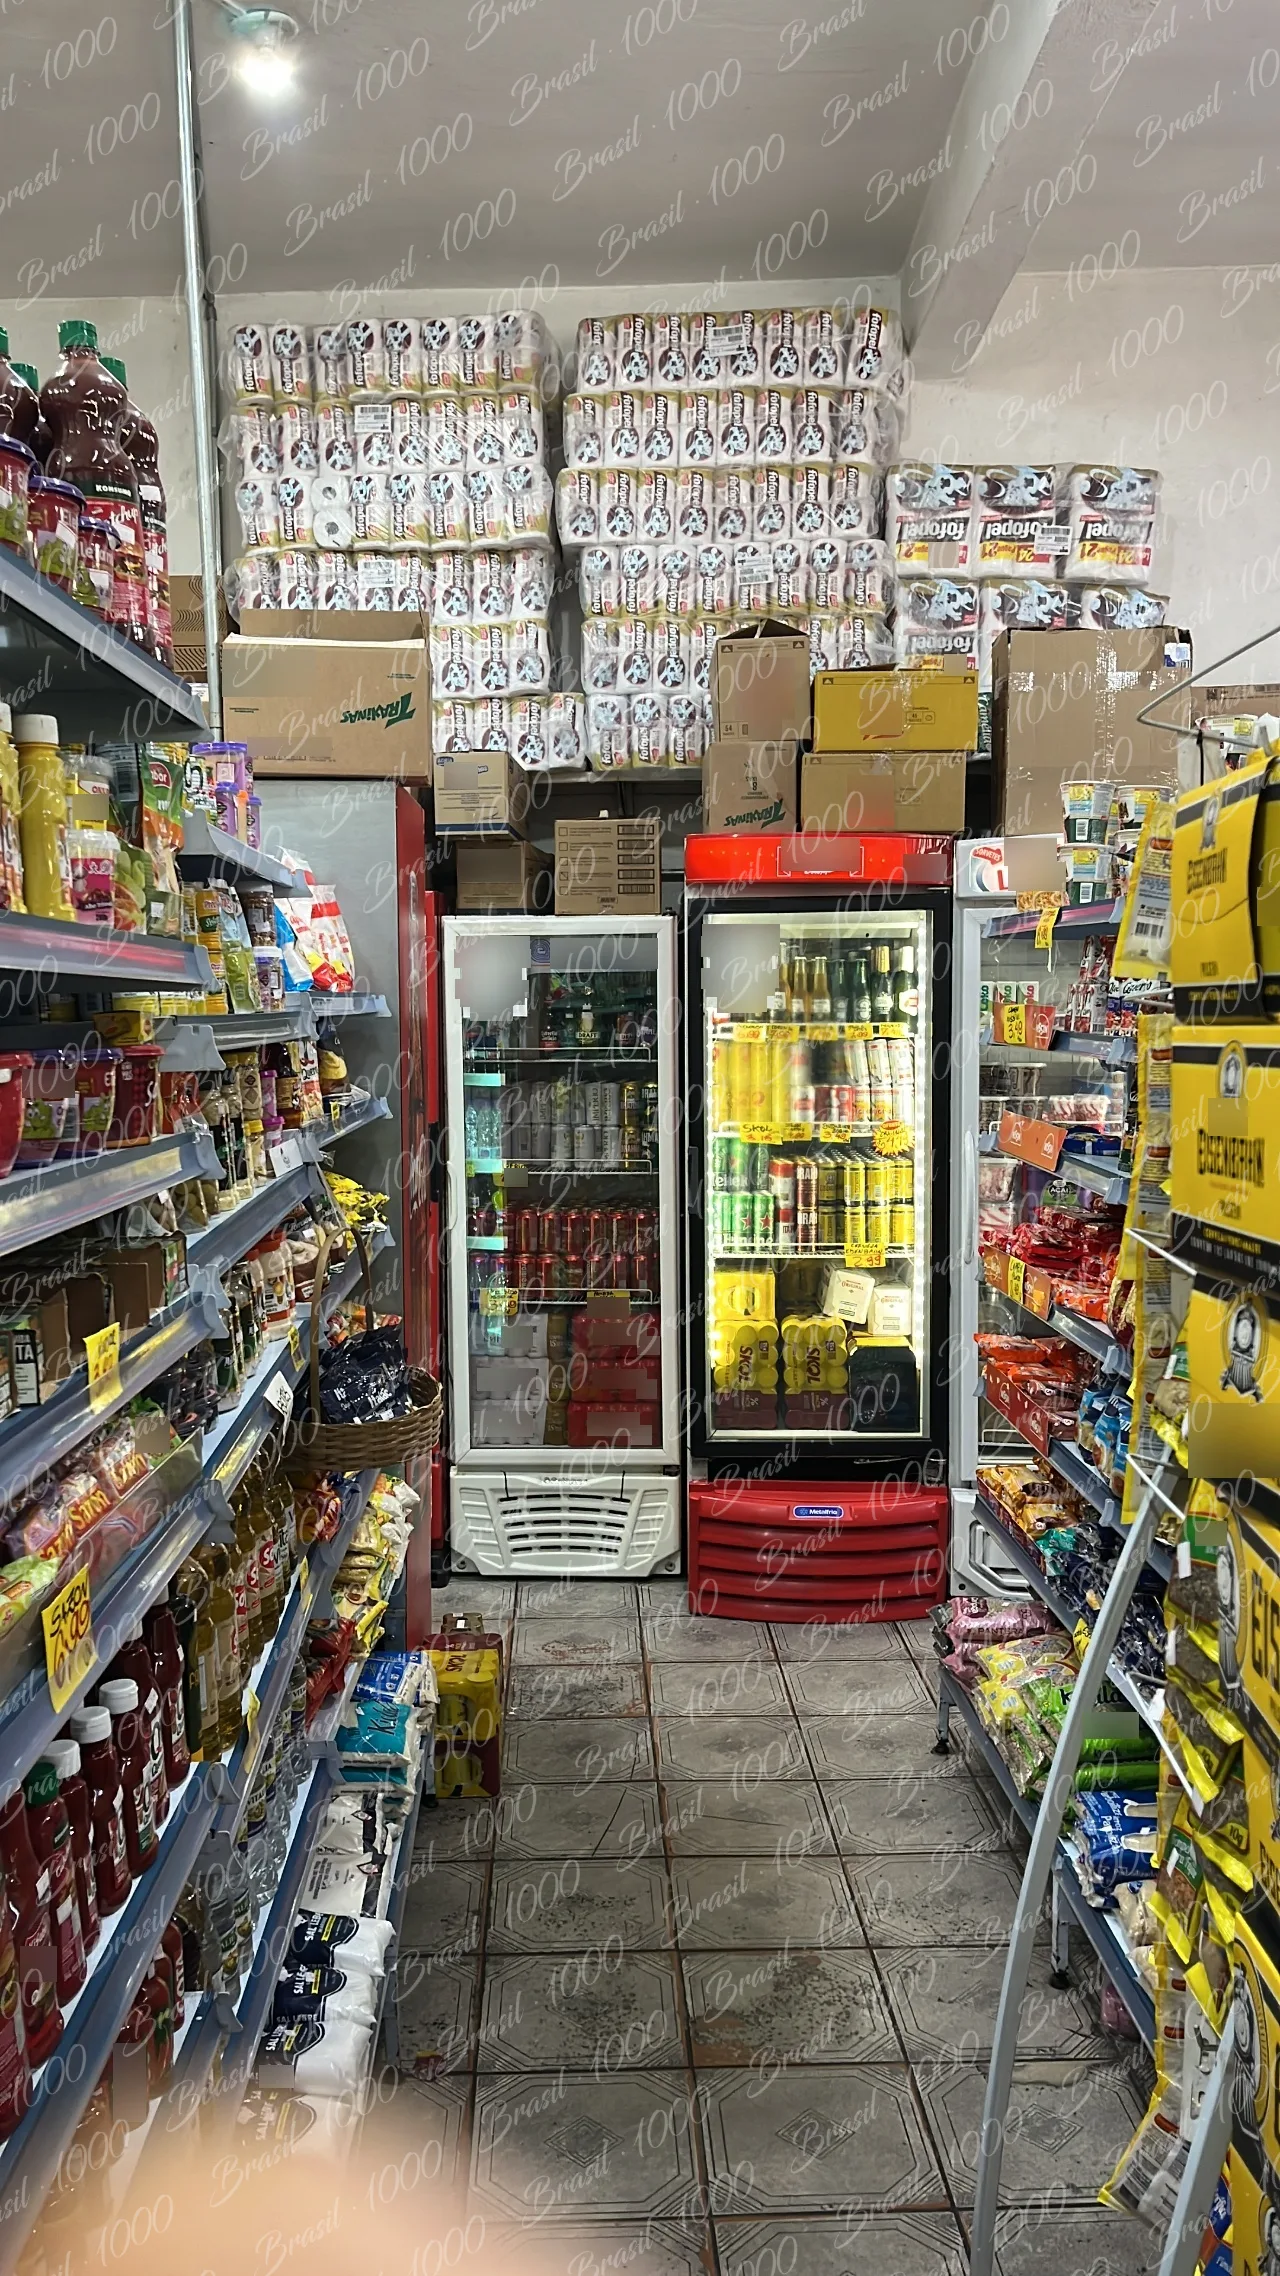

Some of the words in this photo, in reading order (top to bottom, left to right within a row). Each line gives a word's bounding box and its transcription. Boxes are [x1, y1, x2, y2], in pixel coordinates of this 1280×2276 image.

[868, 311, 882, 351] fofopel
[623, 393, 634, 429] fofopel
[657, 395, 667, 432] fofopel
[733, 391, 745, 427] fofopel
[770, 391, 781, 427] fofopel
[904, 519, 965, 541] fofopel
[980, 543, 996, 560] 21
[1017, 550, 1035, 563] 24
[1080, 543, 1097, 560] 21
[339, 691, 416, 730] TRAKINAS
[723, 798, 787, 830] TRAKINAS
[741, 1122, 773, 1133] SKOL
[739, 1345, 754, 1384] SKOL
[806, 1346, 821, 1384] SKOL
[809, 1507, 839, 1517] Metalfrio
